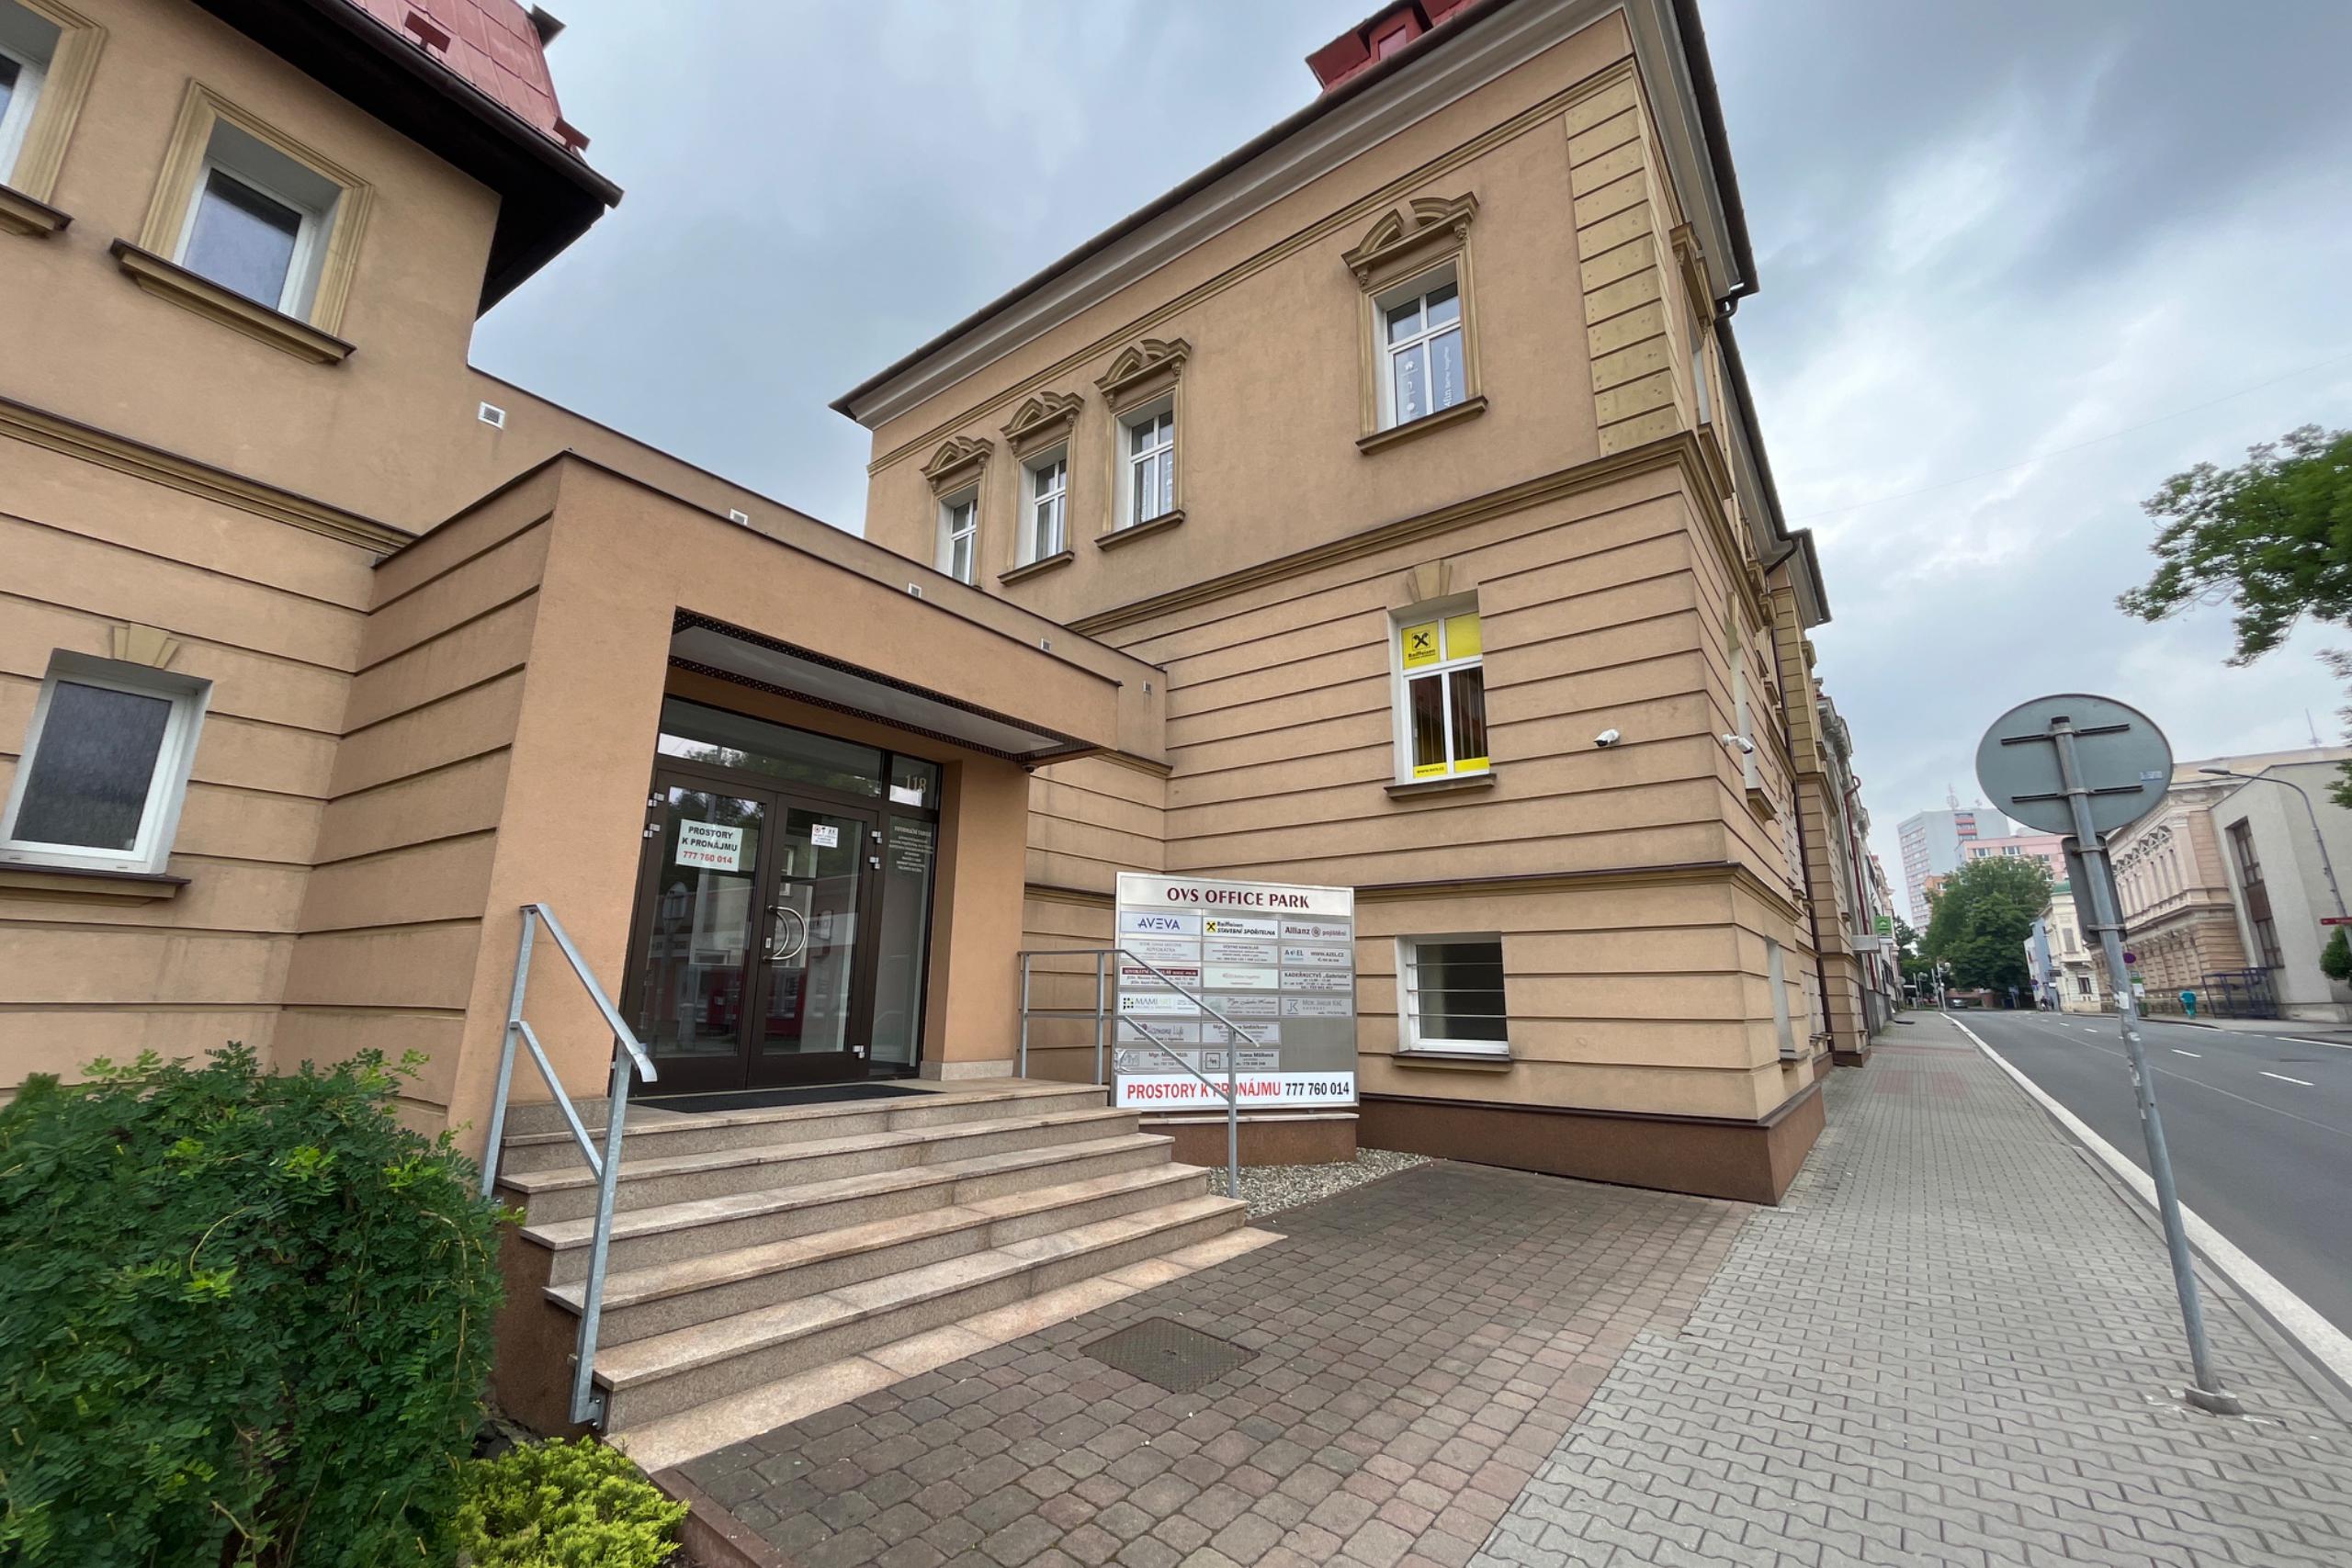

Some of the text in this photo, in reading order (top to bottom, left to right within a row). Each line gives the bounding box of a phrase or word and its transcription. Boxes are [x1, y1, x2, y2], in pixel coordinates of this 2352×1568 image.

[688, 826, 734, 839] PROSTORY
[682, 837, 738, 852] K PRONÁJMU
[683, 851, 697, 860] 777
[717, 855, 732, 863] 014
[1167, 887, 1310, 908] OVS OFFICE PARK
[1137, 918, 1181, 930] AVEVA
[1284, 927, 1310, 935] Allianz
[1126, 1083, 1196, 1100] PROSTORY
[1200, 1082, 1209, 1098] K
[1285, 1082, 1305, 1096] 777
[1308, 1082, 1328, 1096] 760
[1330, 1081, 1350, 1096] 014
